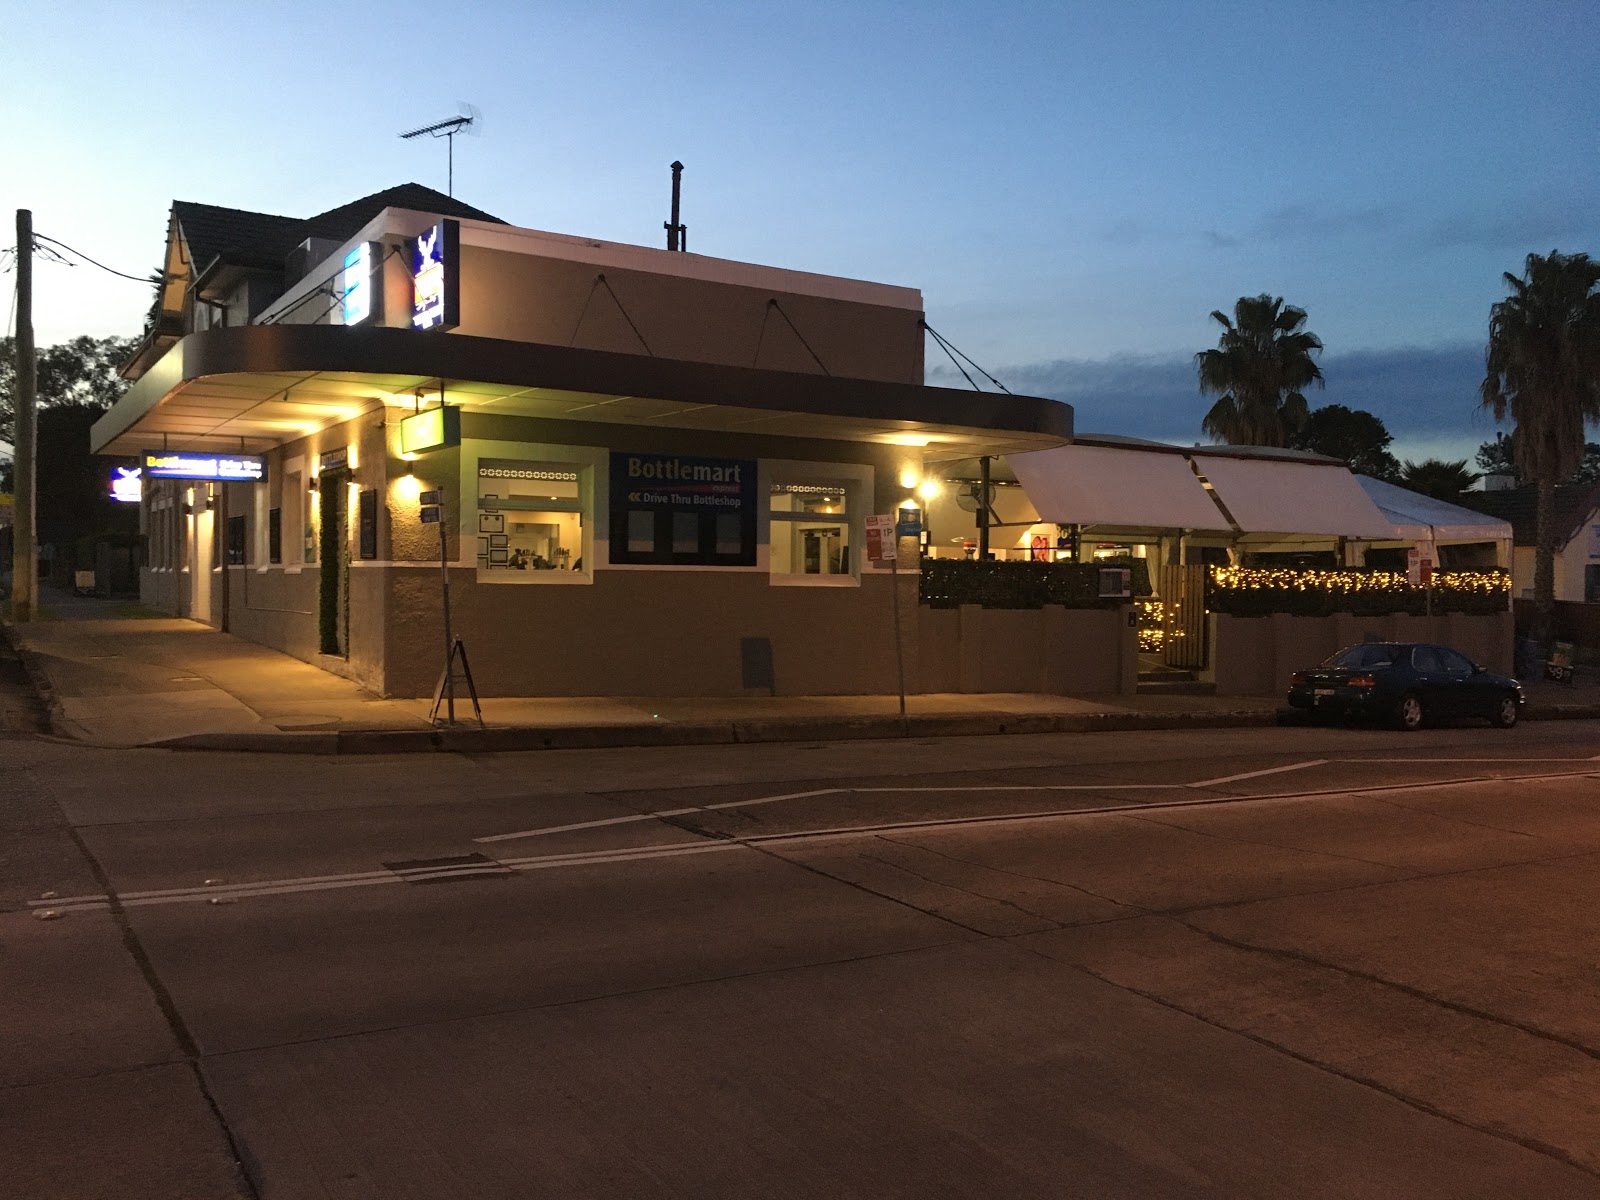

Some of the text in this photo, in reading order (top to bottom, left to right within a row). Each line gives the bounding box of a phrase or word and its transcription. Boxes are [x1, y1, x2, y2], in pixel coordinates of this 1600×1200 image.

[147, 456, 217, 470] Bottl
[628, 457, 741, 482] Bottlemart
[643, 492, 741, 508] Drive Thru Bottleshop
[883, 528, 893, 537] 1P
